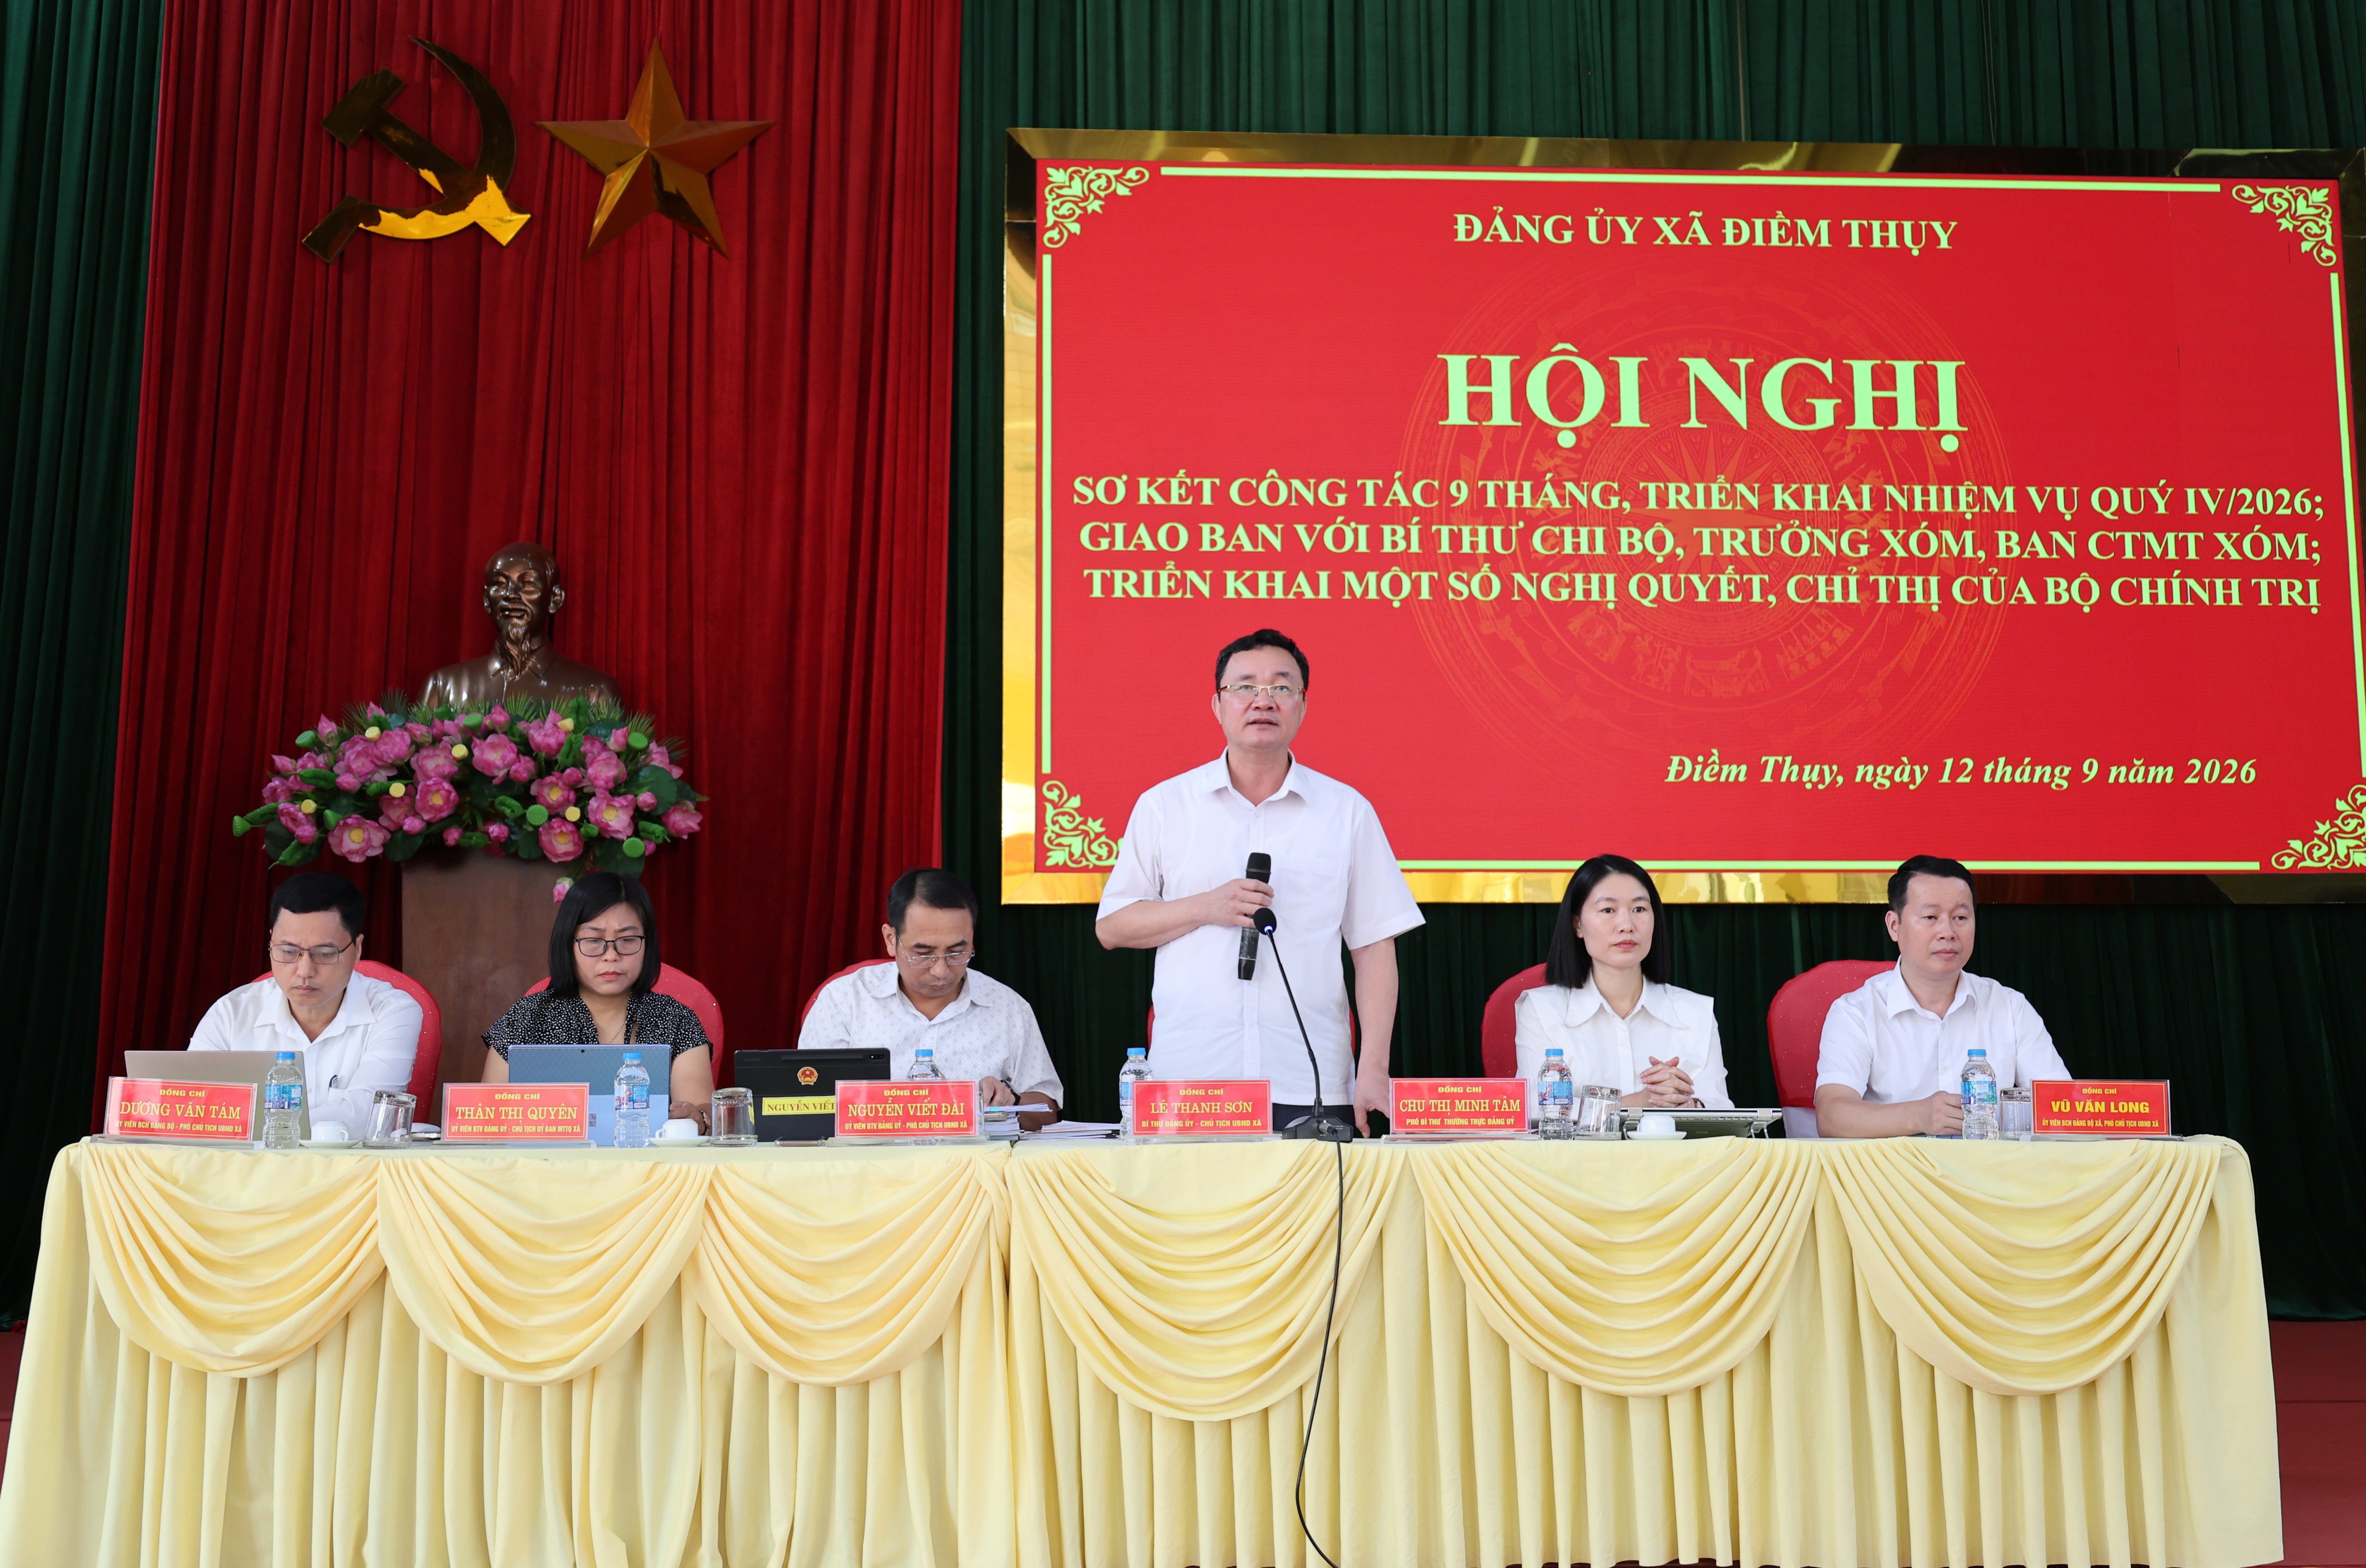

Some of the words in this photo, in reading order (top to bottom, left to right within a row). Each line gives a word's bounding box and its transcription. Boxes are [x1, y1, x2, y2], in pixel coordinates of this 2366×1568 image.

[1454, 206, 1574, 244] ĐẢNG
[1585, 208, 1643, 245] ỦY
[1653, 210, 1712, 246] XÃ
[1722, 210, 1832, 247] ĐIỀM
[1842, 220, 1957, 257] THỤY
[1437, 343, 1650, 448] HỘI
[1678, 357, 1968, 452] NGHỊ
[1073, 474, 1128, 505] SƠ
[1138, 469, 1220, 505] KẾT
[1229, 468, 1347, 507] CÔNG
[1356, 471, 1439, 508] TÁC
[1449, 479, 1469, 506] 9
[1477, 472, 1631, 513] THÁNG,
[1639, 475, 1760, 510] TRIỂN
[1773, 483, 1872, 511] KHAI
[1884, 481, 2016, 520] NHIỆM
[2026, 486, 2079, 521] VỤ
[2090, 479, 2174, 520] QUÝ
[2186, 487, 2324, 520] IV/2026;
[1079, 521, 1189, 552] GIAO
[1200, 523, 1284, 552] BAN
[1294, 516, 1370, 553] VỚI
[1381, 516, 1422, 553] BÍ
[1431, 521, 1525, 554] THƯ
[1532, 525, 1607, 555] CHI
[1618, 522, 1685, 563] BỘ,
[1692, 520, 1870, 558] TRƯỞNG
[1880, 521, 1986, 562] XÓM,
[1996, 530, 2077, 559] BAN
[2088, 530, 2204, 560] CTMT
[2213, 524, 2321, 565] XÓM;
[1083, 561, 1212, 598] TRIỂN
[1224, 570, 1330, 599] KHAI
[1343, 566, 1439, 608] MỘT
[1448, 563, 1502, 601] SỐ
[1512, 572, 1617, 610] NGHỊ
[1628, 565, 1777, 608] QUYẾT,
[1786, 566, 1860, 603] CHỈ
[1869, 575, 1941, 612] THỊ
[1951, 567, 2037, 605] CỦA
[2045, 572, 2100, 613] BỘ
[2110, 569, 2242, 606] CHÍNH
[2251, 578, 2320, 614] TRỊ
[1665, 748, 1748, 783] Điềm
[1760, 755, 1844, 790] Thụy,
[1855, 756, 1929, 790] ngày
[1939, 757, 1974, 783] 12
[1983, 756, 2072, 790] tháng
[2082, 758, 2099, 783] 9
[2108, 759, 2174, 784] năm
[2184, 758, 2257, 784] 2026
[120, 1100, 171, 1116] DƯƠNG
[175, 1101, 206, 1118] VĂN
[210, 1103, 241, 1119] TÁM
[455, 1103, 495, 1119] THÂN
[499, 1107, 523, 1123] THỊ
[527, 1103, 578, 1120] QUYÊN
[767, 1100, 809, 1112] NGUYỄN
[813, 1099, 835, 1110] VIẾT
[848, 1097, 904, 1117] NGUYỄN
[907, 1097, 938, 1116] VIẾT
[941, 1099, 965, 1115] ĐÀI
[1150, 1099, 1168, 1114] LÊ
[1171, 1102, 1221, 1113] THANH
[1225, 1100, 1253, 1113] SƠN
[1399, 1100, 1425, 1112] CHU
[1429, 1100, 1451, 1116] THỊ
[1454, 1100, 1489, 1112] MINH
[1492, 1095, 1521, 1112] TÂM
[2051, 1099, 2071, 1112] VŨ
[2075, 1099, 2106, 1113] VĂN
[2110, 1102, 2150, 1113] LONG
[124, 1119, 136, 1128] VIÊN
[150, 1120, 166, 1129] ĐẢNG
[167, 1121, 175, 1131] BỘ
[179, 1122, 190, 1130] PHÓ
[192, 1121, 203, 1131] CHỦ
[205, 1125, 217, 1133] TỊCH
[234, 1125, 242, 1133] XÃ
[460, 1124, 472, 1133] VIÊN
[484, 1123, 499, 1133] ĐẢNG
[512, 1123, 523, 1133] CHỦ
[524, 1126, 536, 1134] TỊCH
[573, 1124, 580, 1133] XÃ
[853, 1121, 866, 1130] VIÊN
[878, 1119, 893, 1129] ĐẢNG
[906, 1120, 917, 1129] PHÓ
[918, 1119, 930, 1129] CHỦ
[931, 1122, 943, 1130] TỊCH
[960, 1120, 968, 1128] XÃ
[1141, 1119, 1149, 1127] BÍ
[1165, 1118, 1183, 1127] ĐẢNG
[1200, 1118, 1214, 1127] CHỦ
[1215, 1120, 1230, 1128] TỊCH
[1406, 1117, 1419, 1125] PHÓ
[1420, 1116, 1427, 1125] BÍ
[1443, 1116, 1469, 1125] THƯỜNG
[1470, 1117, 1486, 1126] TRỰC
[1487, 1116, 1505, 1125] ĐẢNG
[2073, 1118, 2086, 1126] ĐẢNG
[2087, 1119, 2094, 1128] BỘ
[2095, 1119, 2103, 1128] XÃ,
[2104, 1119, 2114, 1127] PHÓ
[2115, 1118, 2125, 1127] CHỦ
